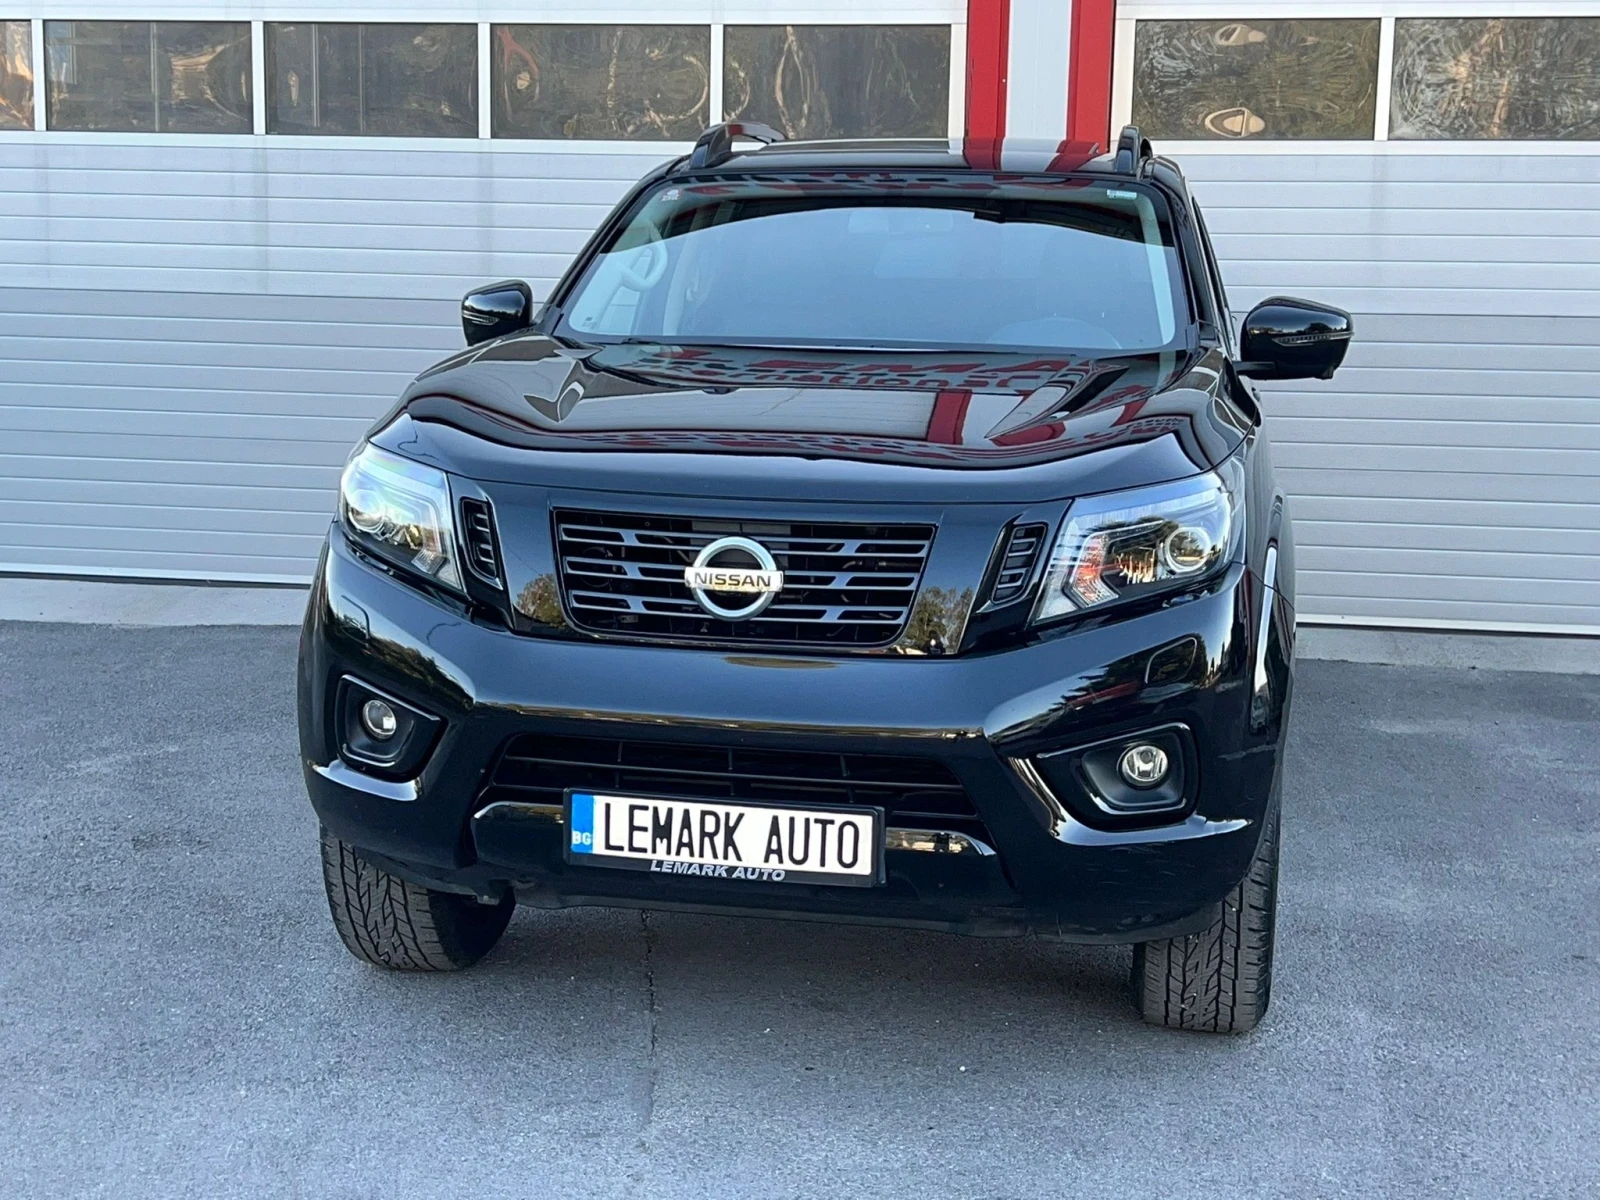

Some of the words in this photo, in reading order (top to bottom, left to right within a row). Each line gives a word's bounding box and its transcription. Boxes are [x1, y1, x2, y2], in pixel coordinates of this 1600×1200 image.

[694, 572, 772, 588] NISSAN
[571, 830, 592, 846] BG
[604, 802, 745, 862] LEMARK
[763, 815, 860, 869] AUTO
[650, 860, 728, 878] LEMARK
[732, 866, 786, 882] AUTO
